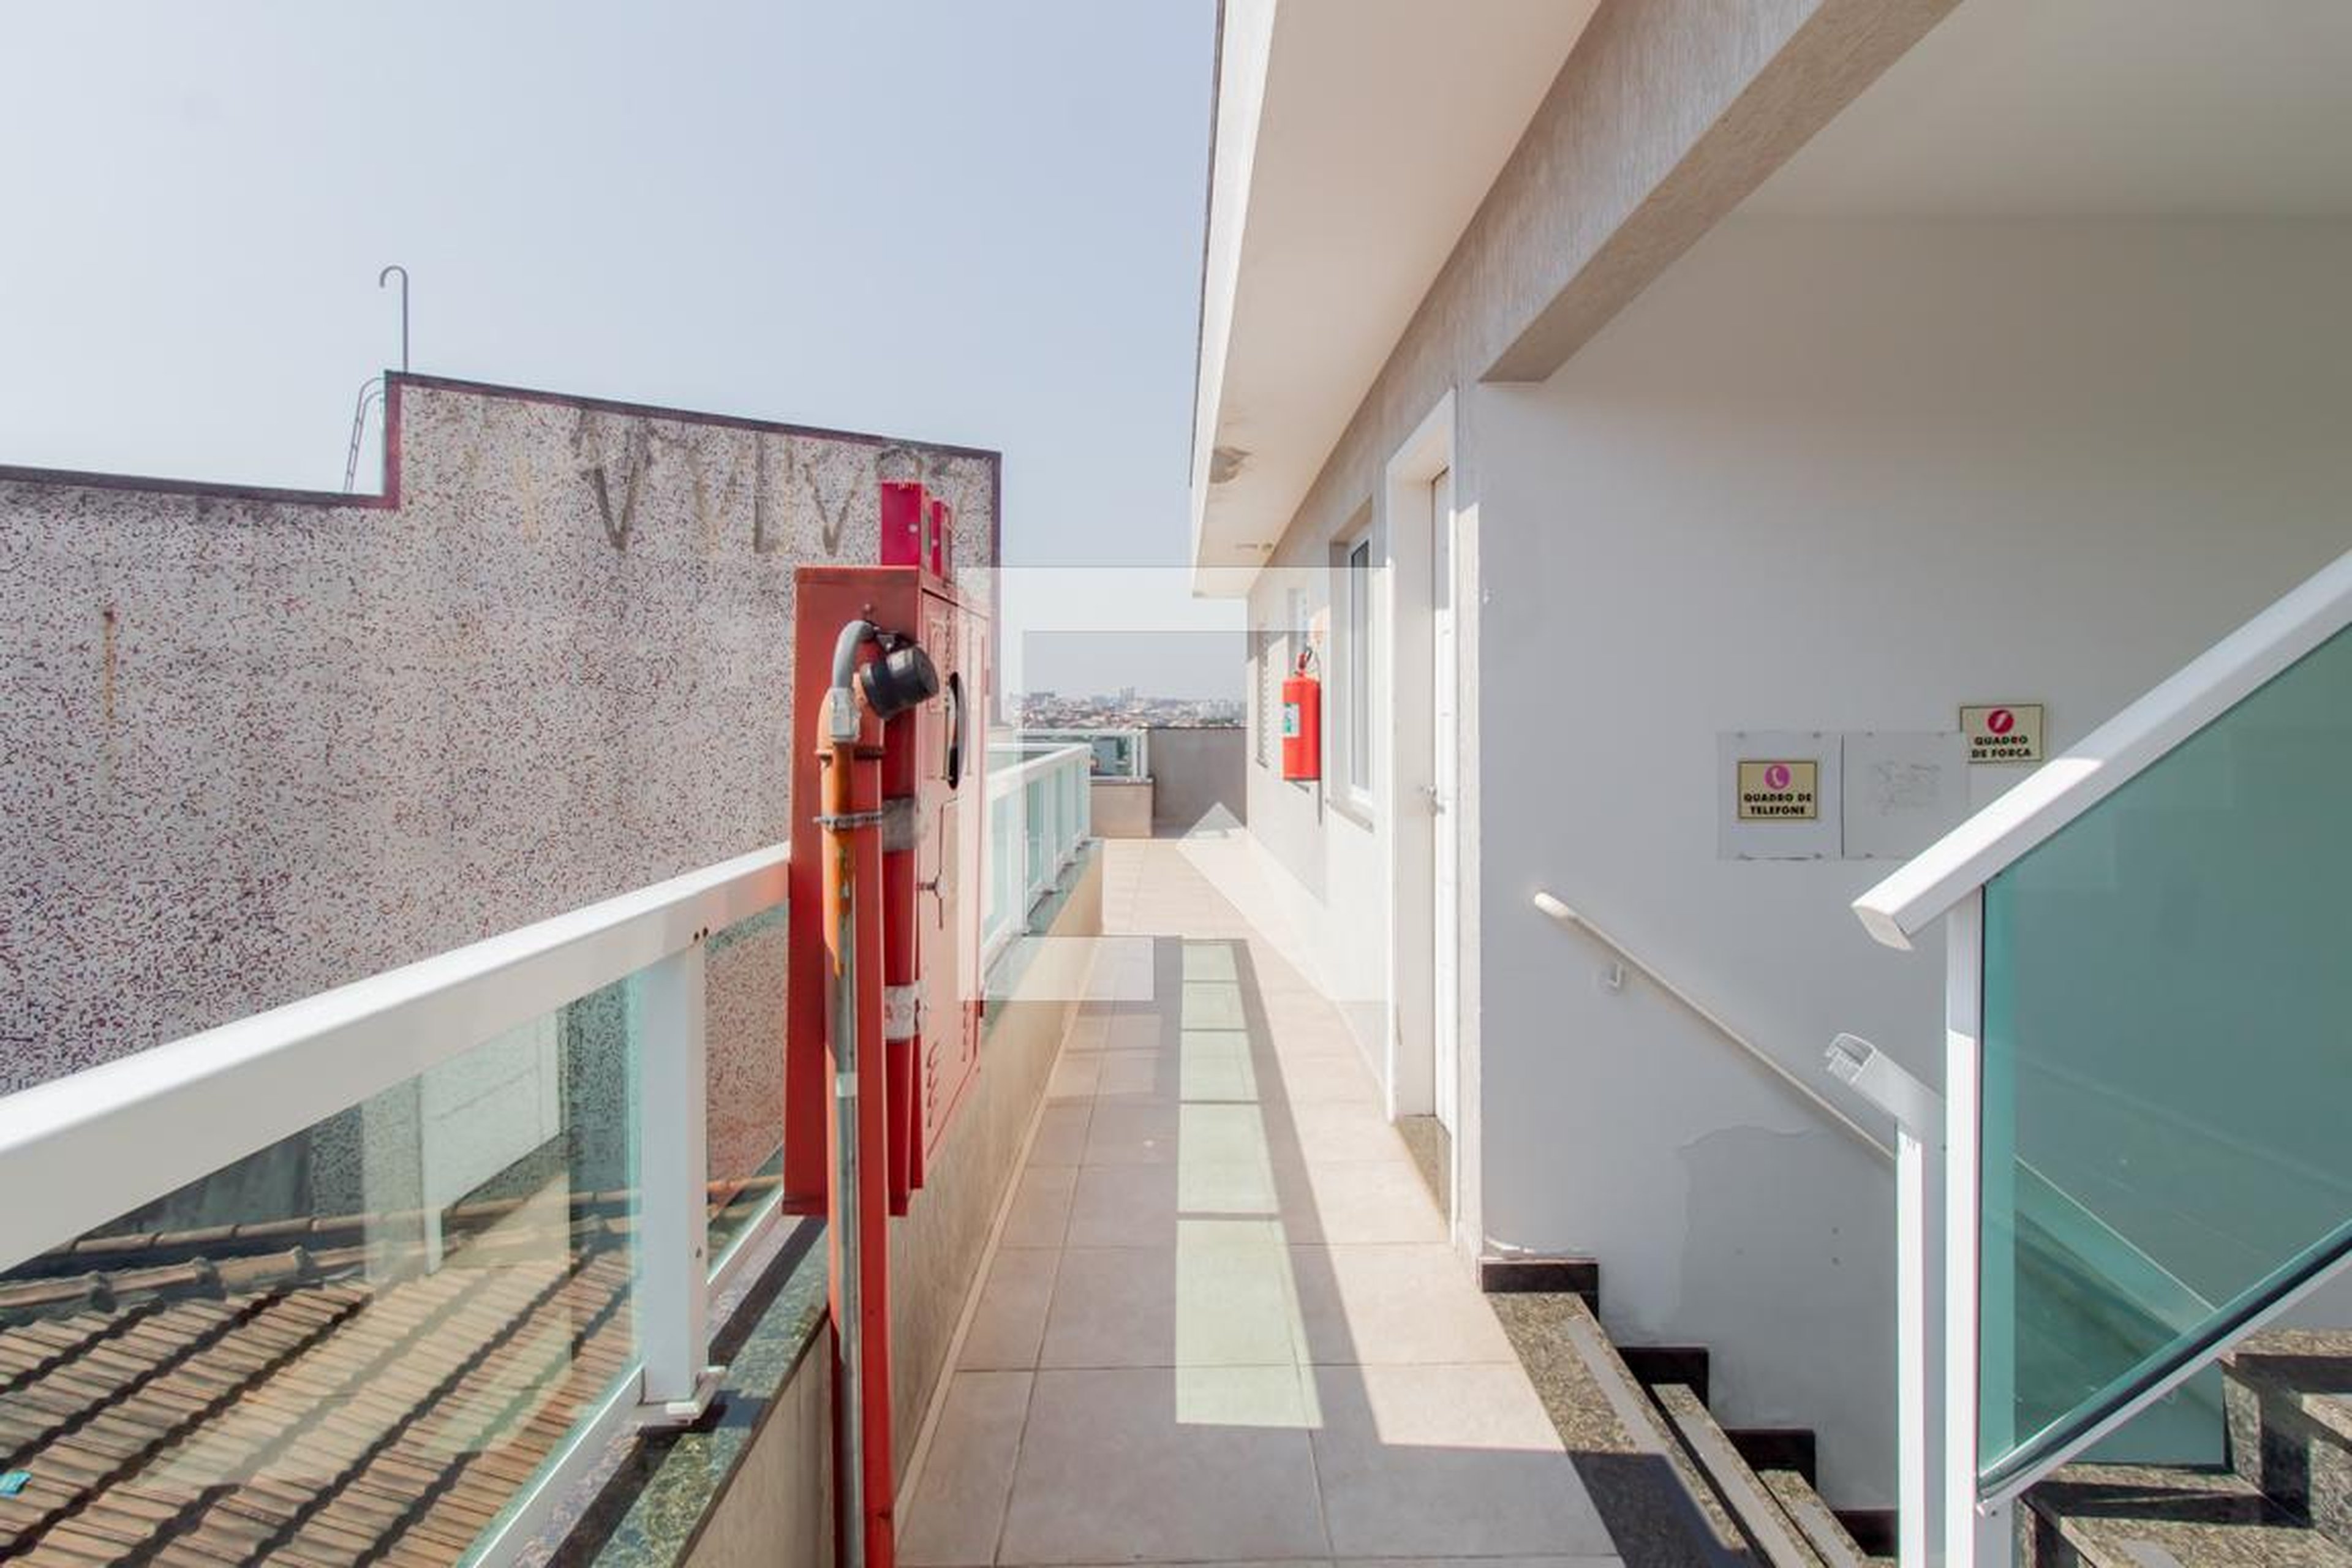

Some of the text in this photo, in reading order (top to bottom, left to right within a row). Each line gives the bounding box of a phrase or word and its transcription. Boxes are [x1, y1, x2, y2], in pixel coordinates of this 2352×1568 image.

[1974, 735, 2028, 745] QUADRO
[1972, 748, 1987, 758] DE
[1744, 793, 1812, 802] QUADRO DE
[1751, 805, 1804, 815] TELEFONE
